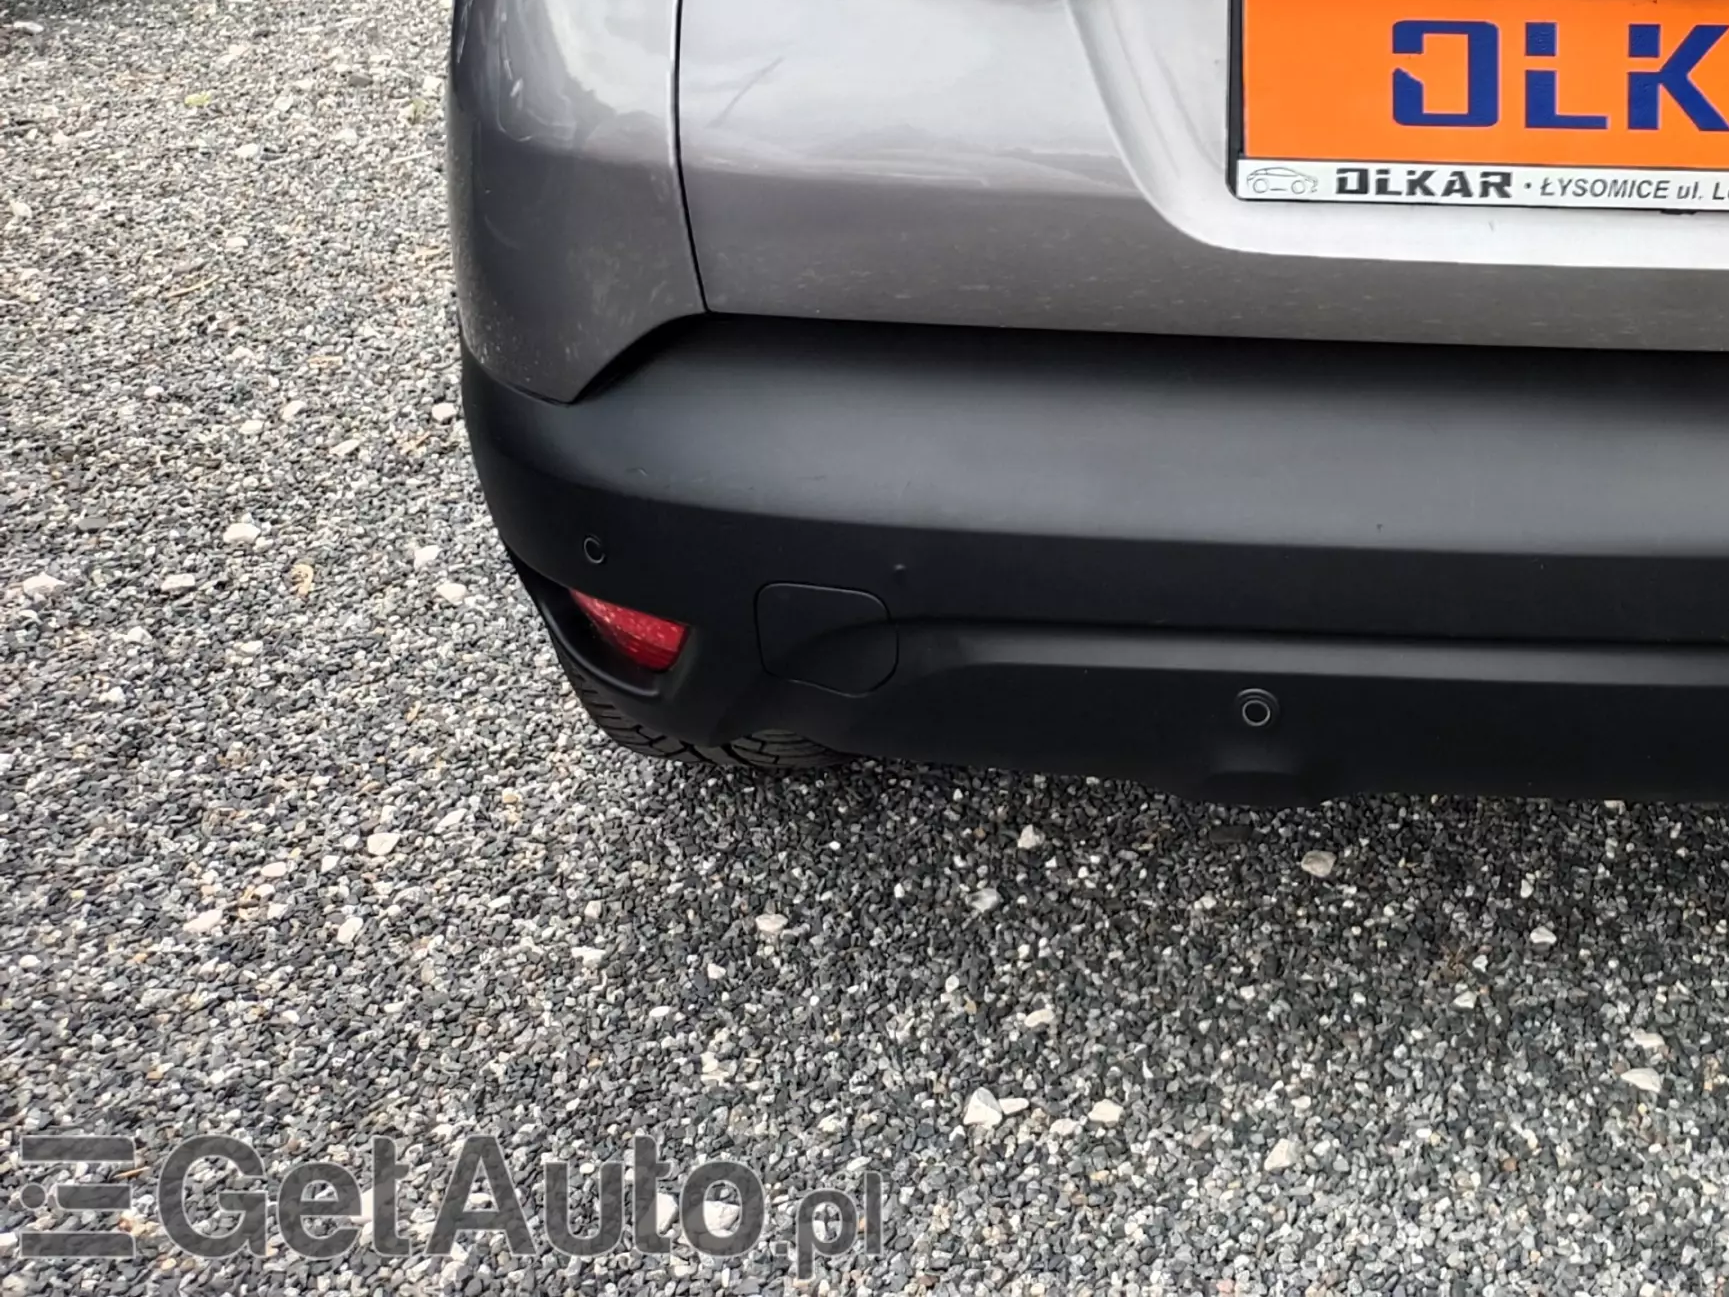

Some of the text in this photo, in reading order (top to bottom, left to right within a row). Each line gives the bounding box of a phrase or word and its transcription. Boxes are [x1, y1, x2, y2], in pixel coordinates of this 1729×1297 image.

[1334, 166, 1513, 199] OLKAR
[1539, 177, 1670, 200] ŁYSOMICE
[1676, 180, 1703, 201] ul.
